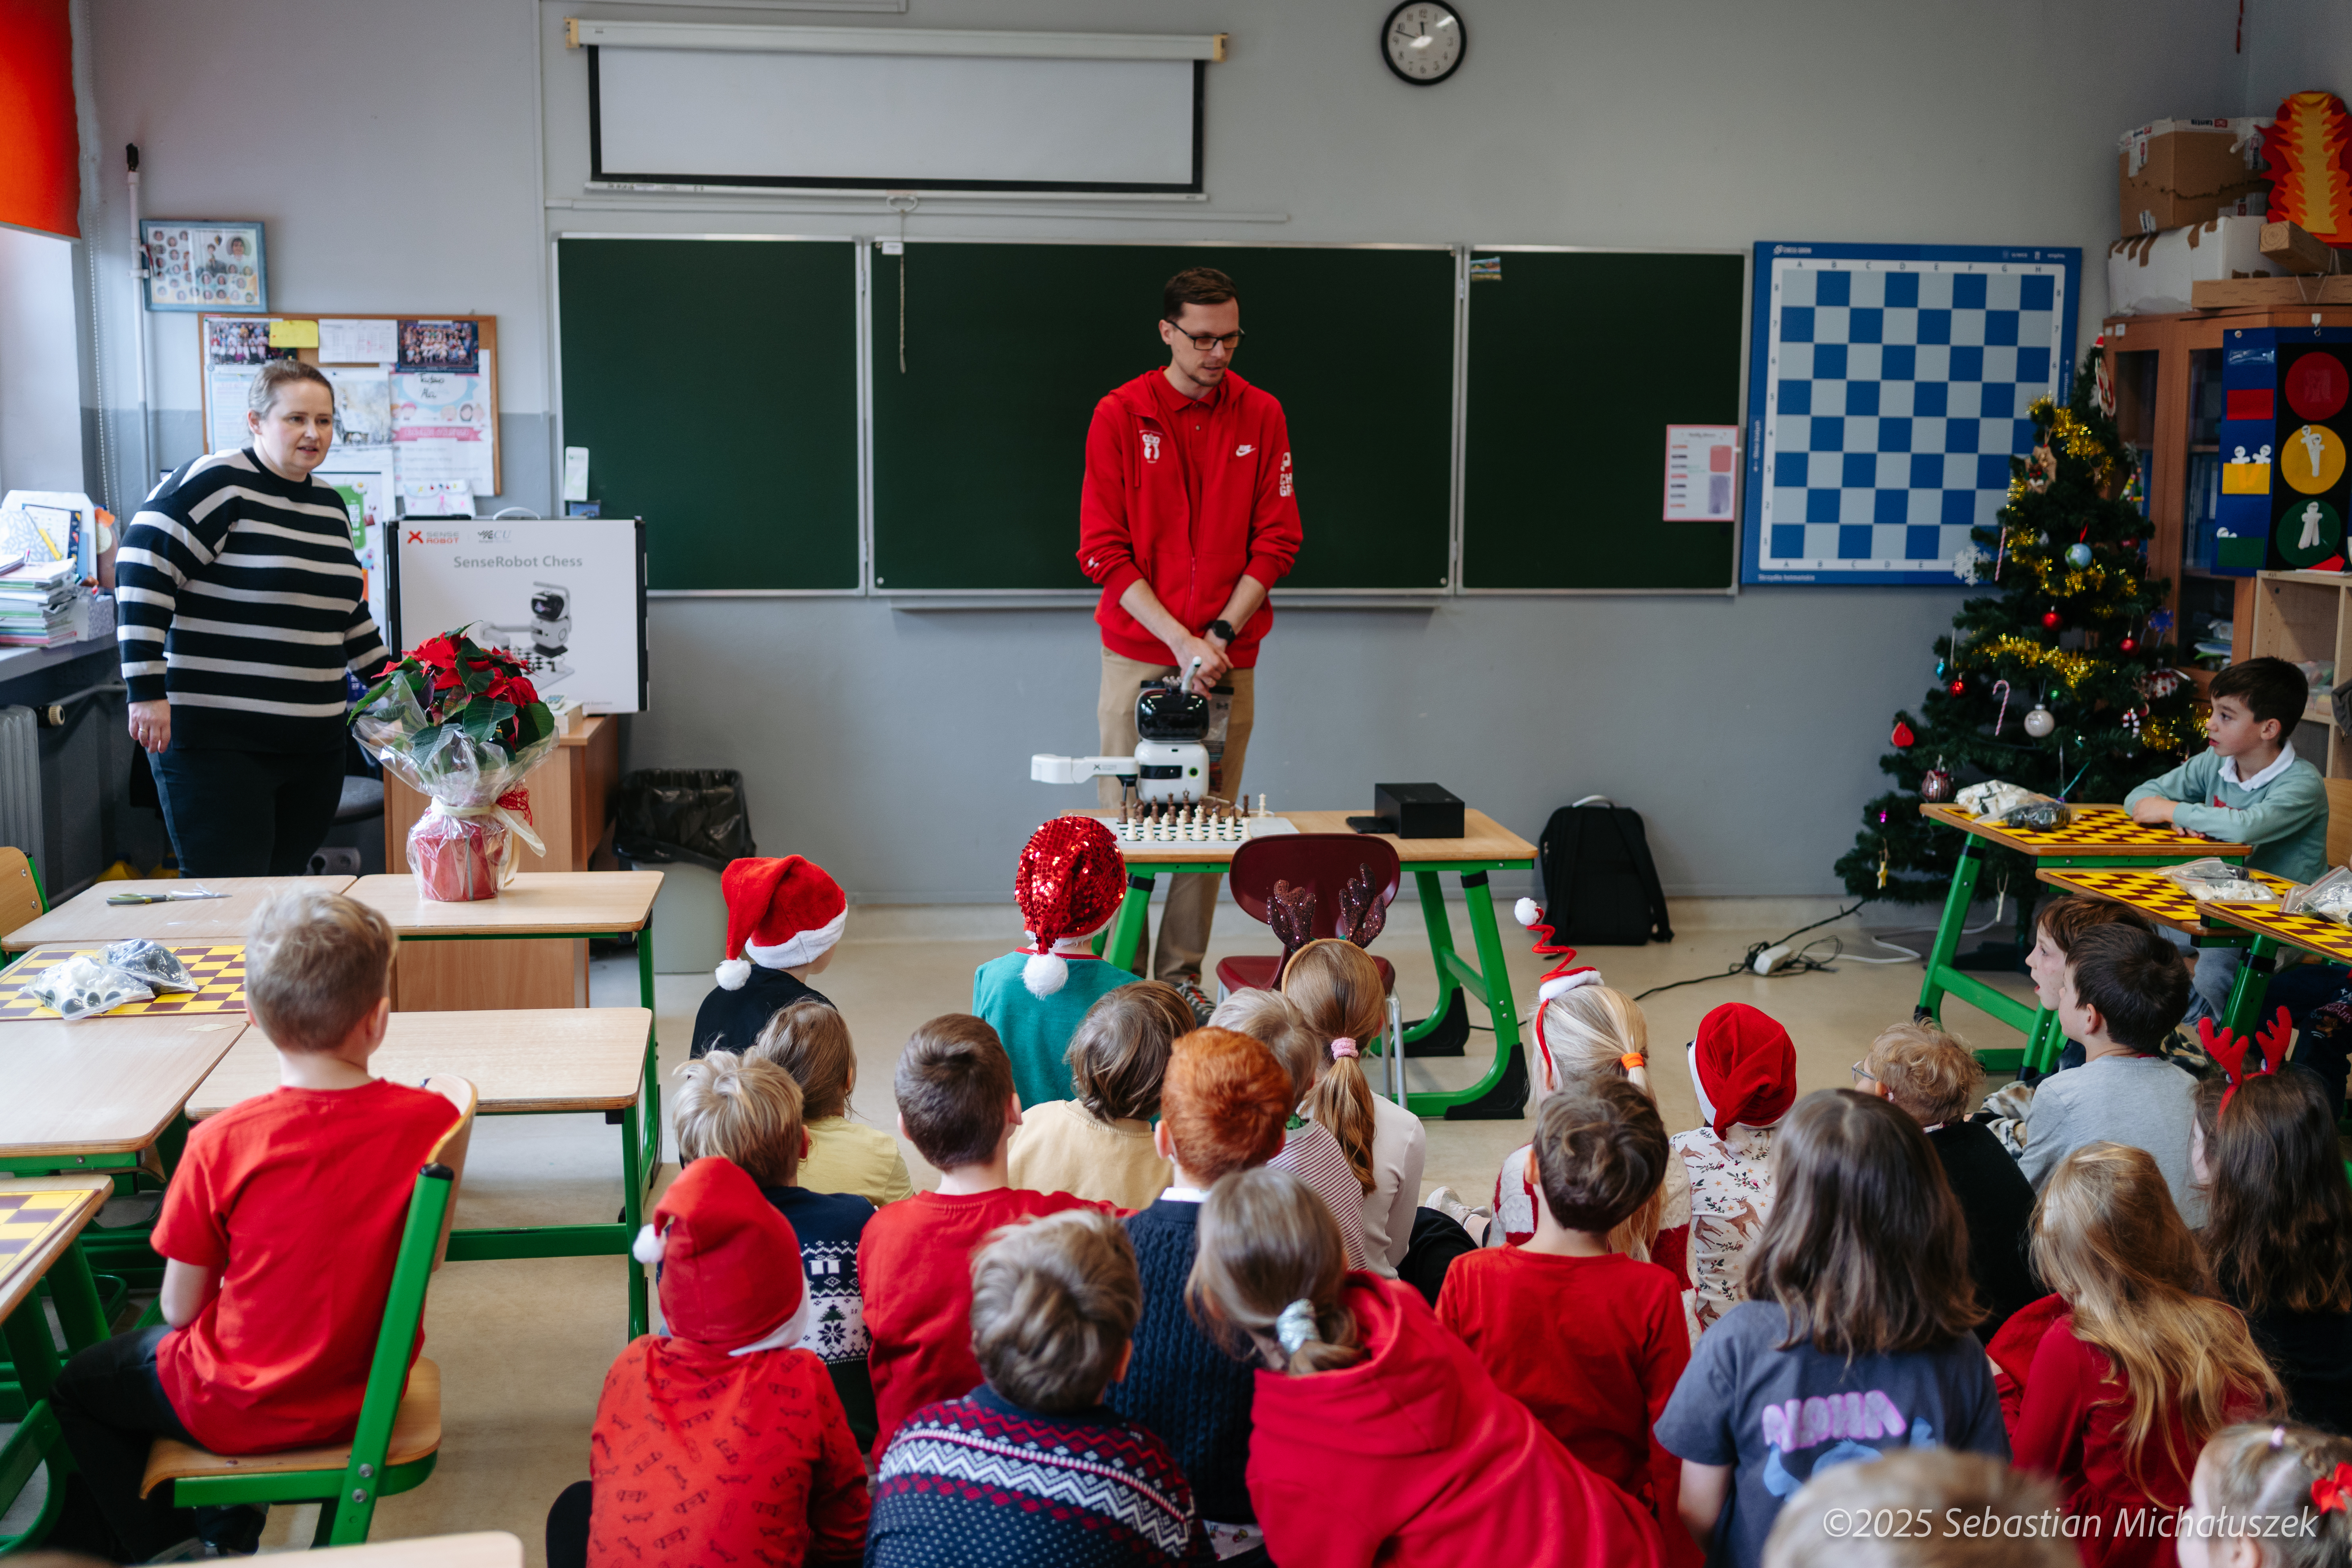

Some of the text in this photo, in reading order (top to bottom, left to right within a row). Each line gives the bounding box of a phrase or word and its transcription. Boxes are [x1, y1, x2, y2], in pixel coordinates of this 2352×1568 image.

[1419, 8, 1427, 18] 12
[1831, 261, 1837, 269] B
[1865, 261, 1871, 269] C
[2002, 264, 2007, 273] G
[454, 555, 582, 568] SenseRobot Chess
[1762, 1390, 1907, 1453] ALOHA
